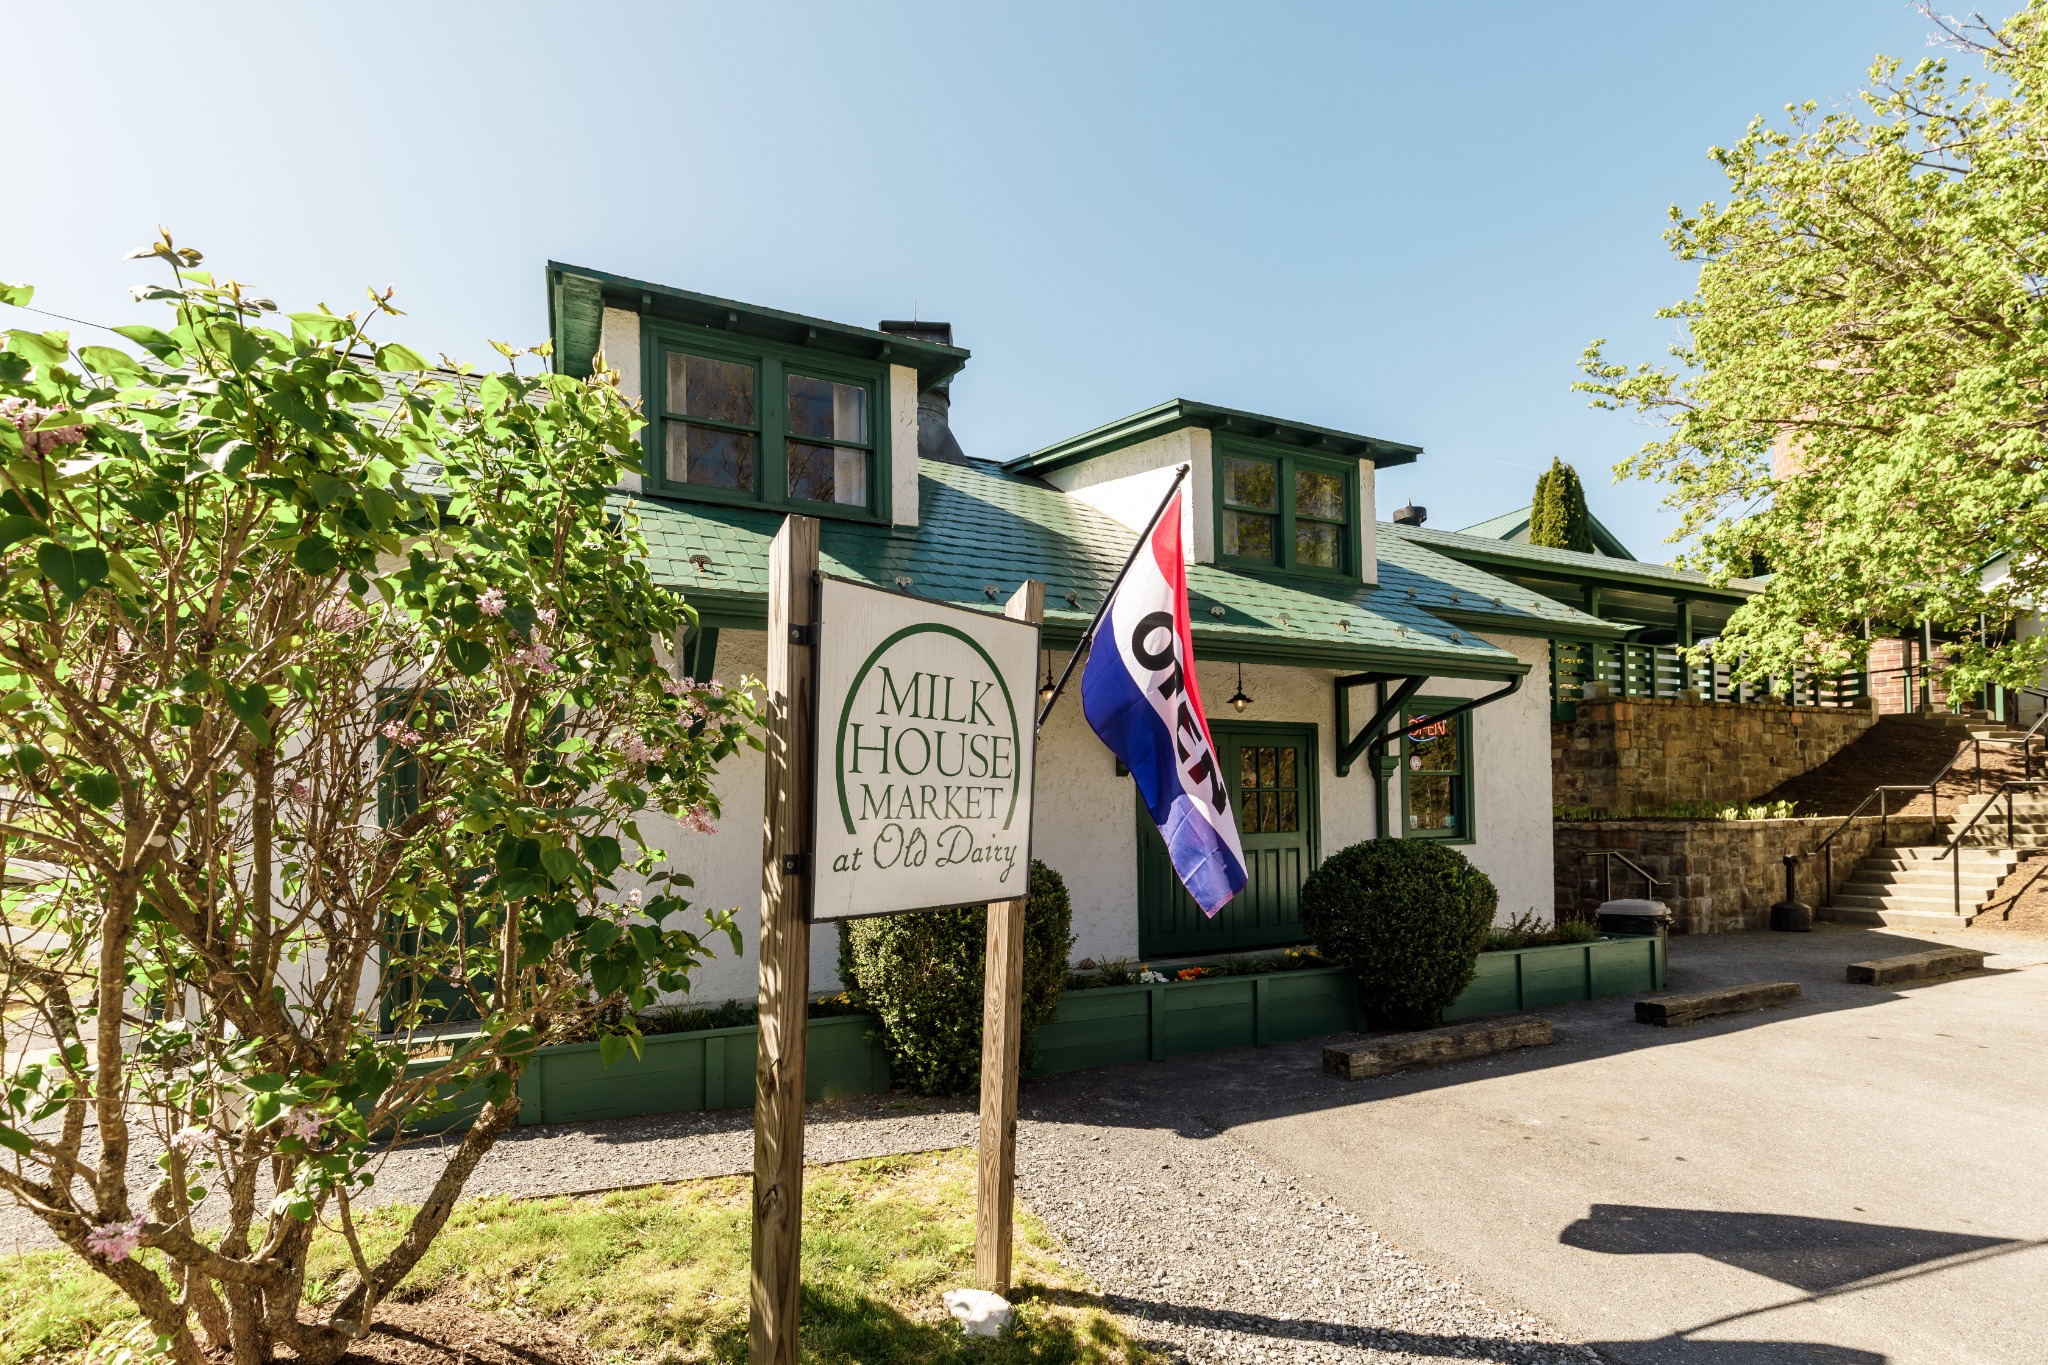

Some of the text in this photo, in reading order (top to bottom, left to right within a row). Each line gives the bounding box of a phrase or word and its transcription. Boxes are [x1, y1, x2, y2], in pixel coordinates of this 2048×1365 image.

[876, 665, 996, 727] MILK
[848, 722, 1013, 779] HOUSE
[859, 783, 1004, 821] MARKET
[832, 822, 1018, 884] at Old Dairy
